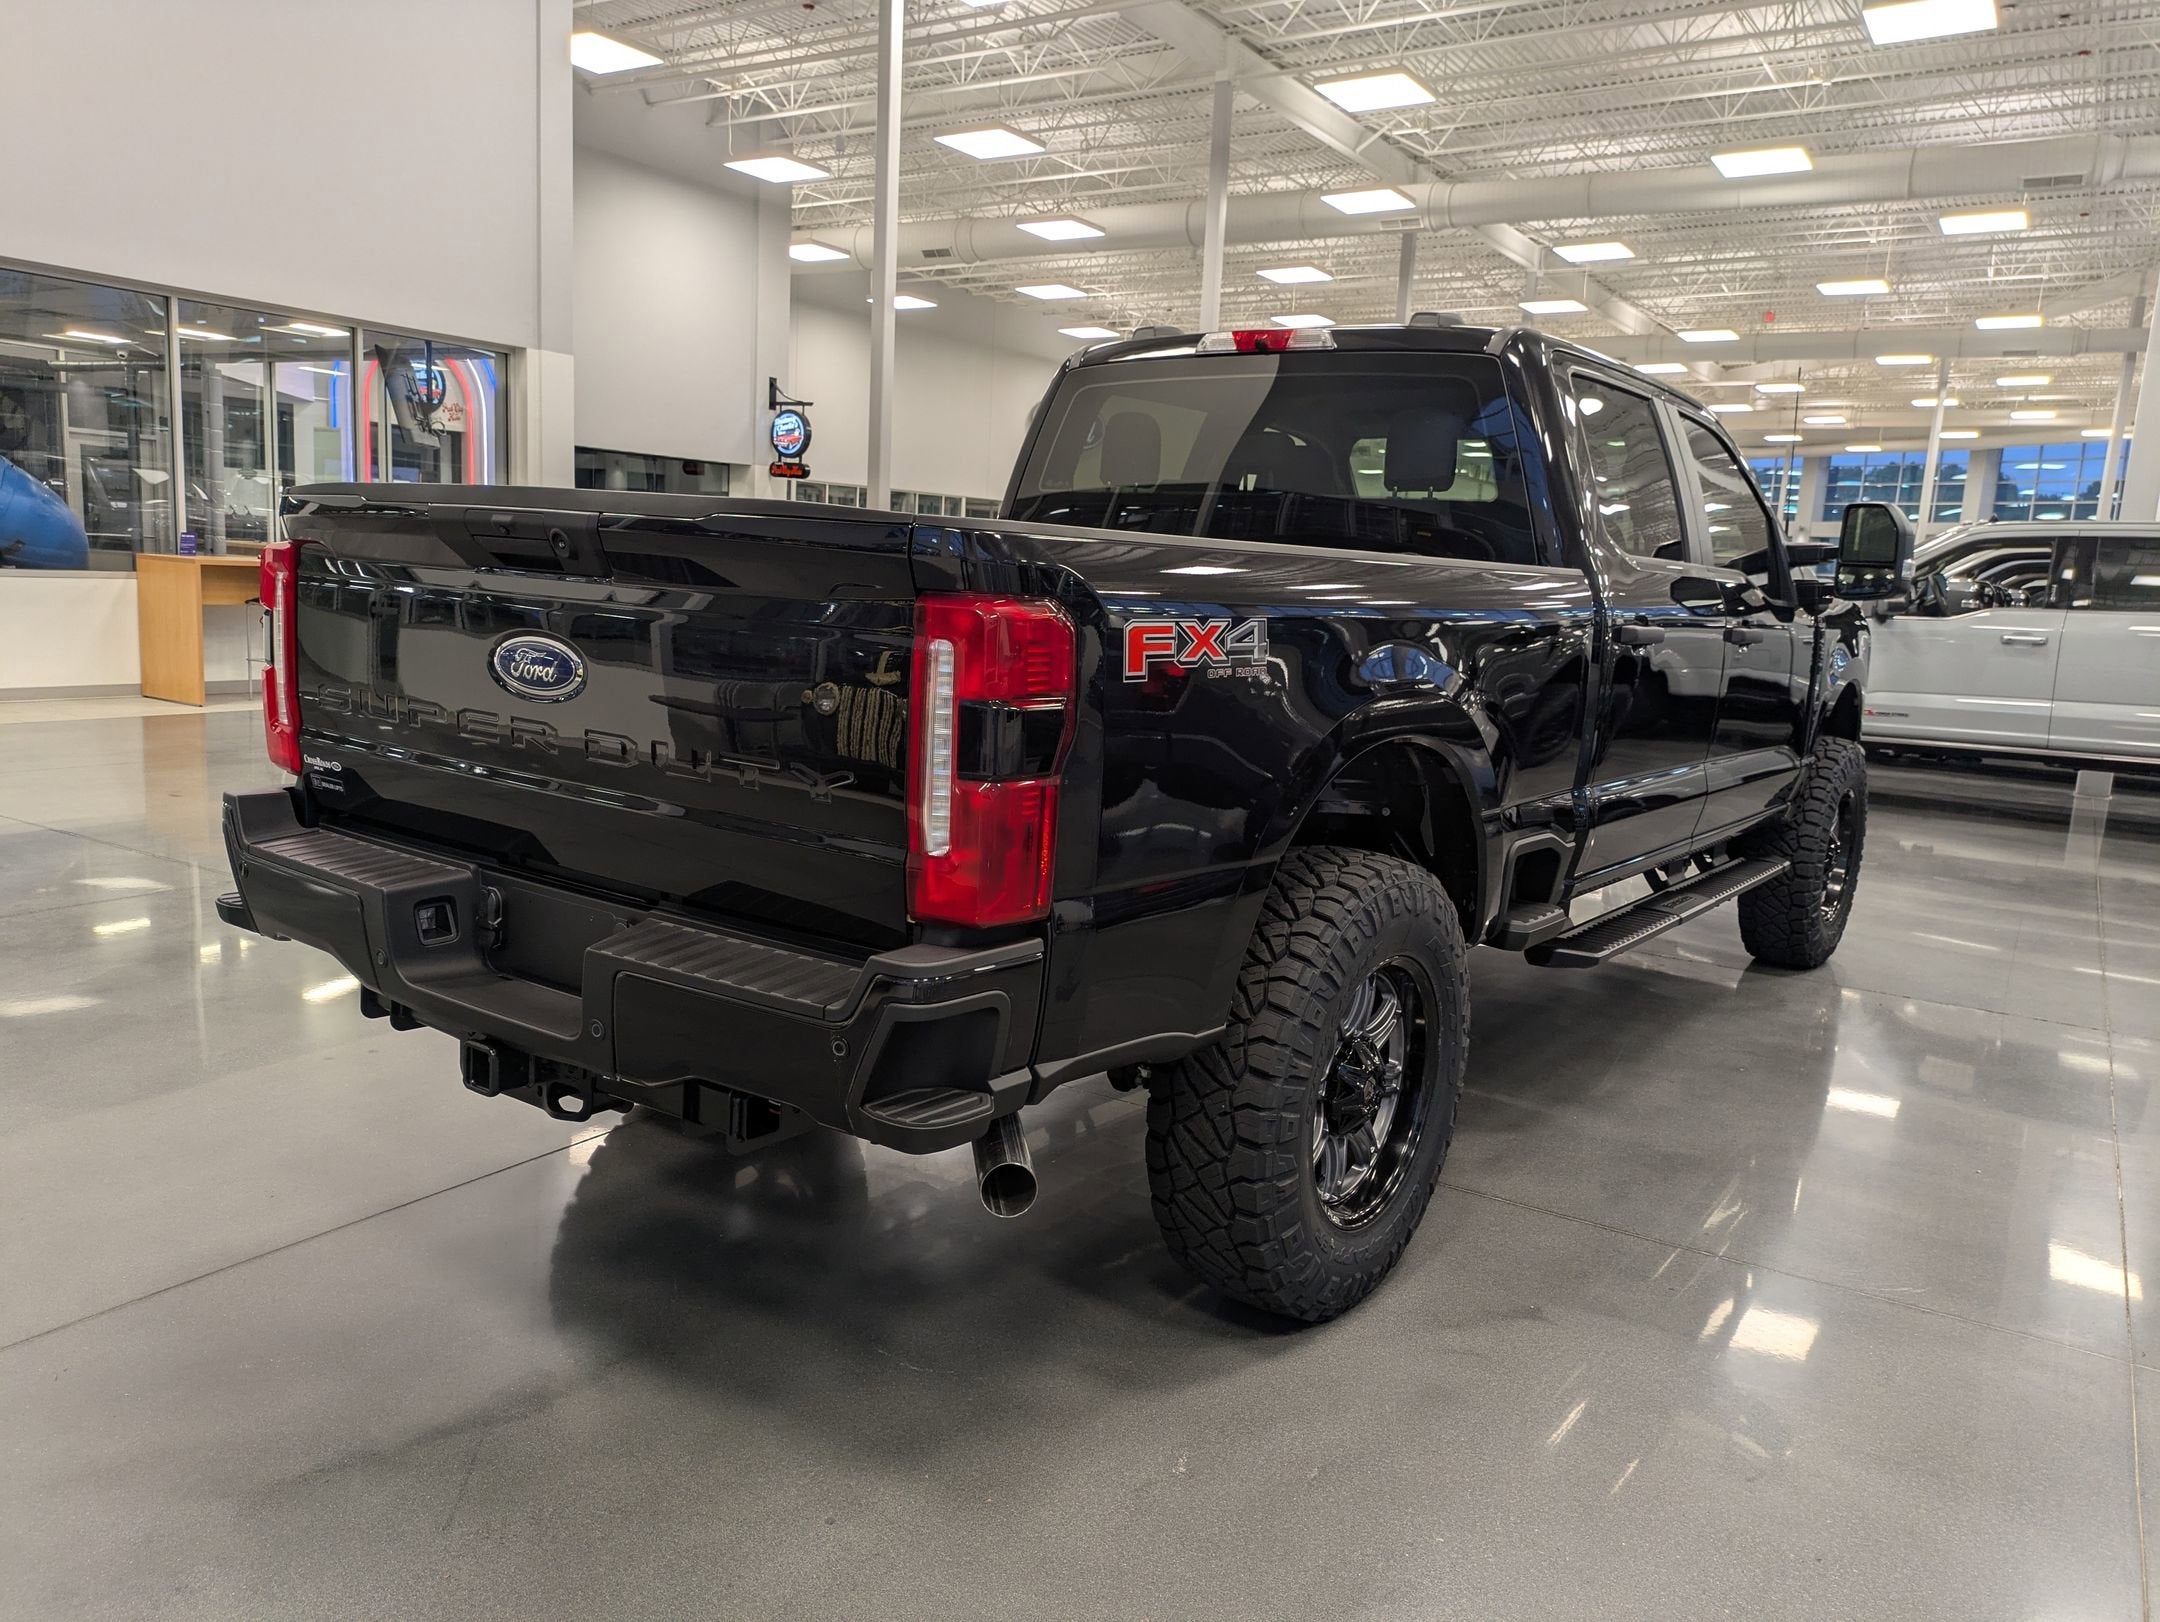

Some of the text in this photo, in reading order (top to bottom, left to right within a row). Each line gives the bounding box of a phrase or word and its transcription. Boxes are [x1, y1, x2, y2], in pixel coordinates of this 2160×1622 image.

[510, 647, 559, 684] Ford
[1123, 618, 1270, 683] FX4
[1207, 666, 1267, 679] OFF ROAD
[316, 683, 855, 804] SUPER DUTY
